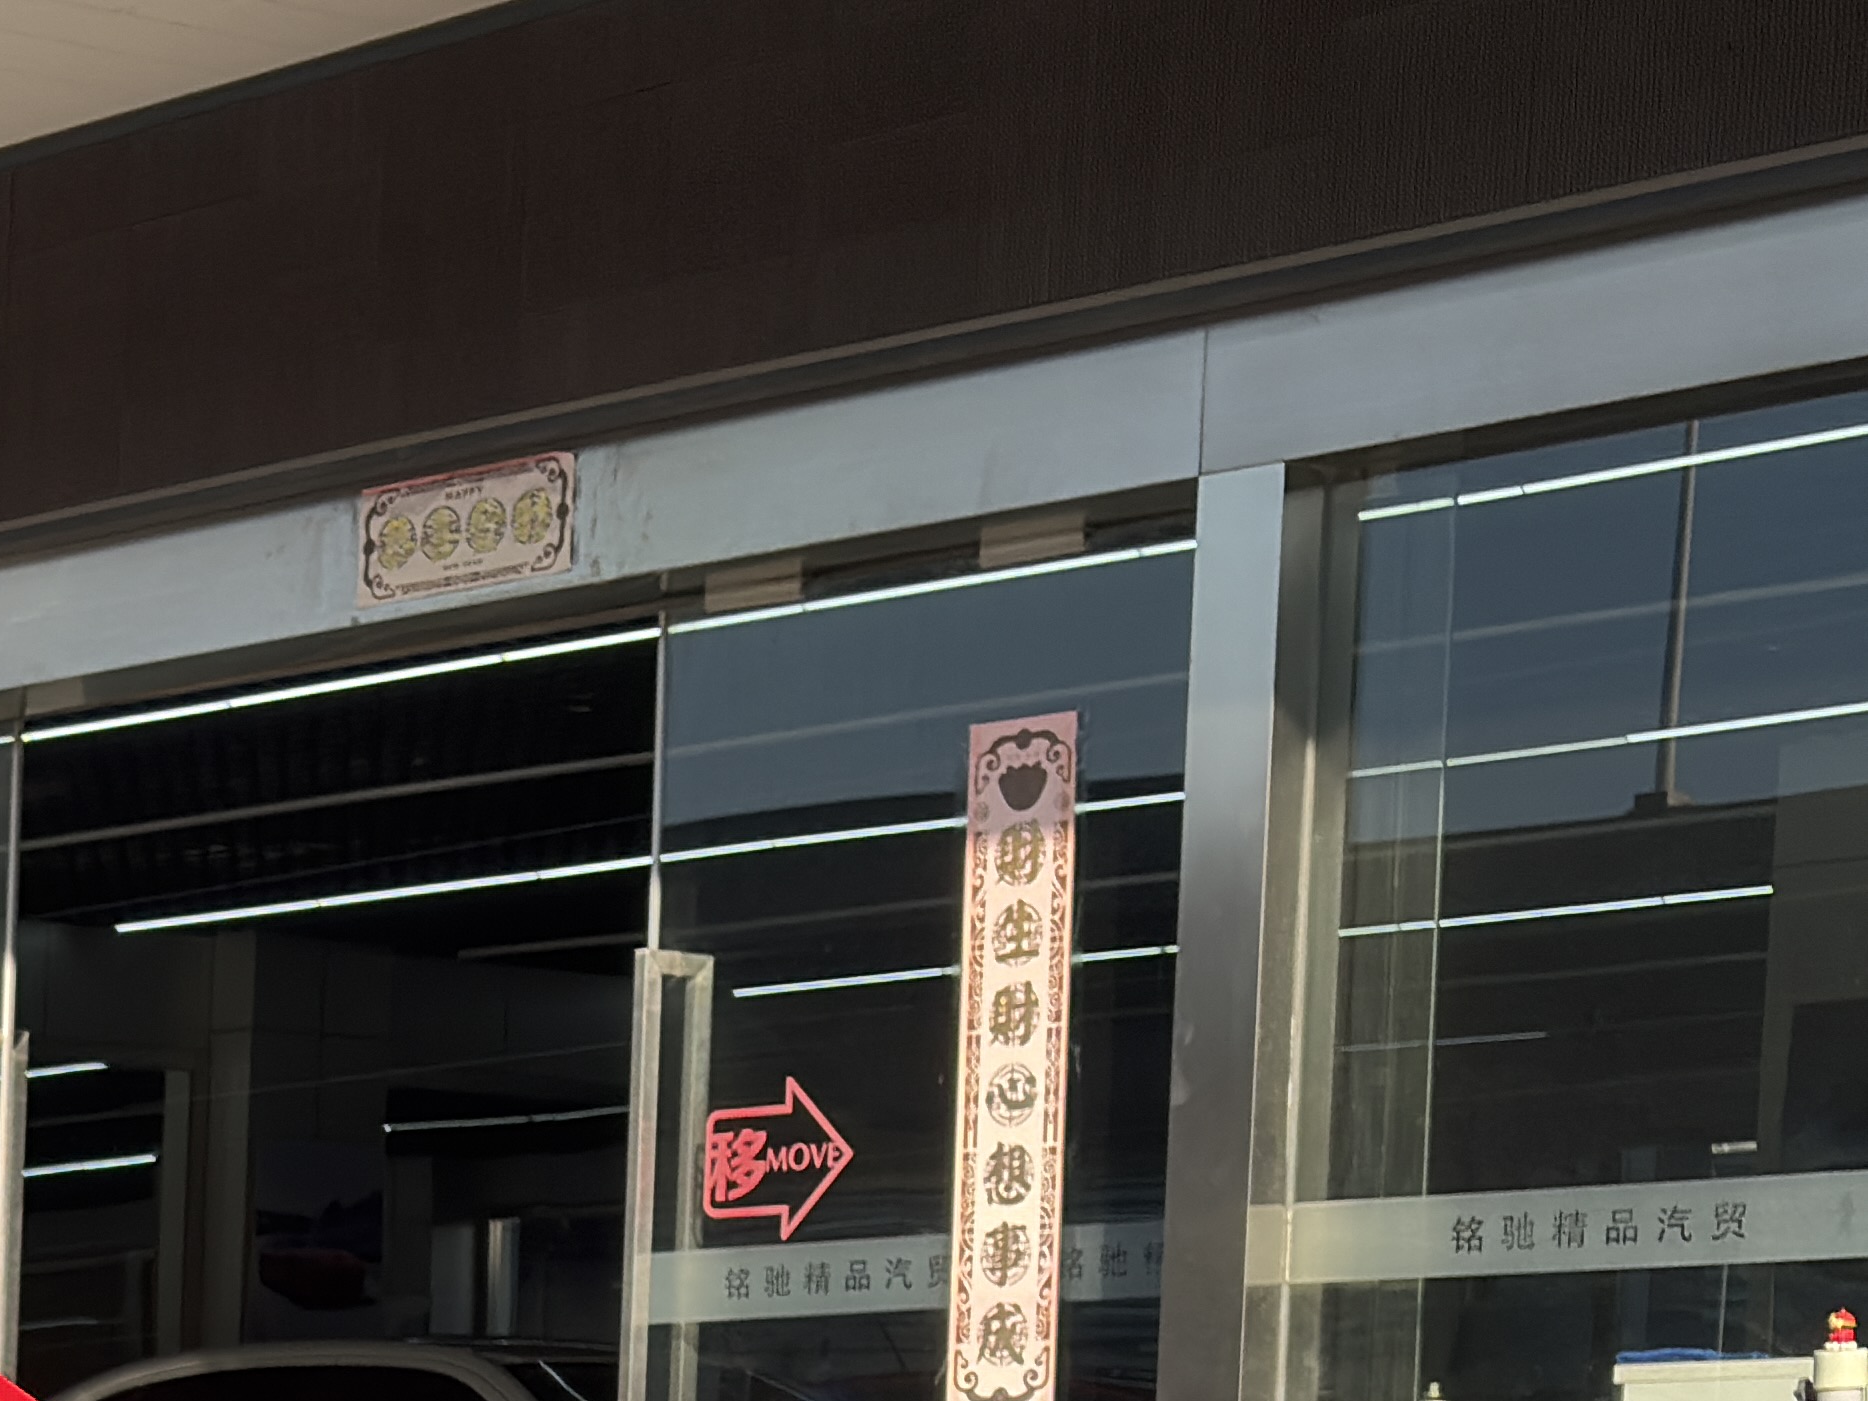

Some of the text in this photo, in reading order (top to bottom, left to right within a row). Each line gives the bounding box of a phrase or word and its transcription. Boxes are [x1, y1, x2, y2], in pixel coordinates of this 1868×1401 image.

[709, 1128, 841, 1202] 移 MOVE
[1451, 1201, 1748, 1255] 铭驰精品汽贸
